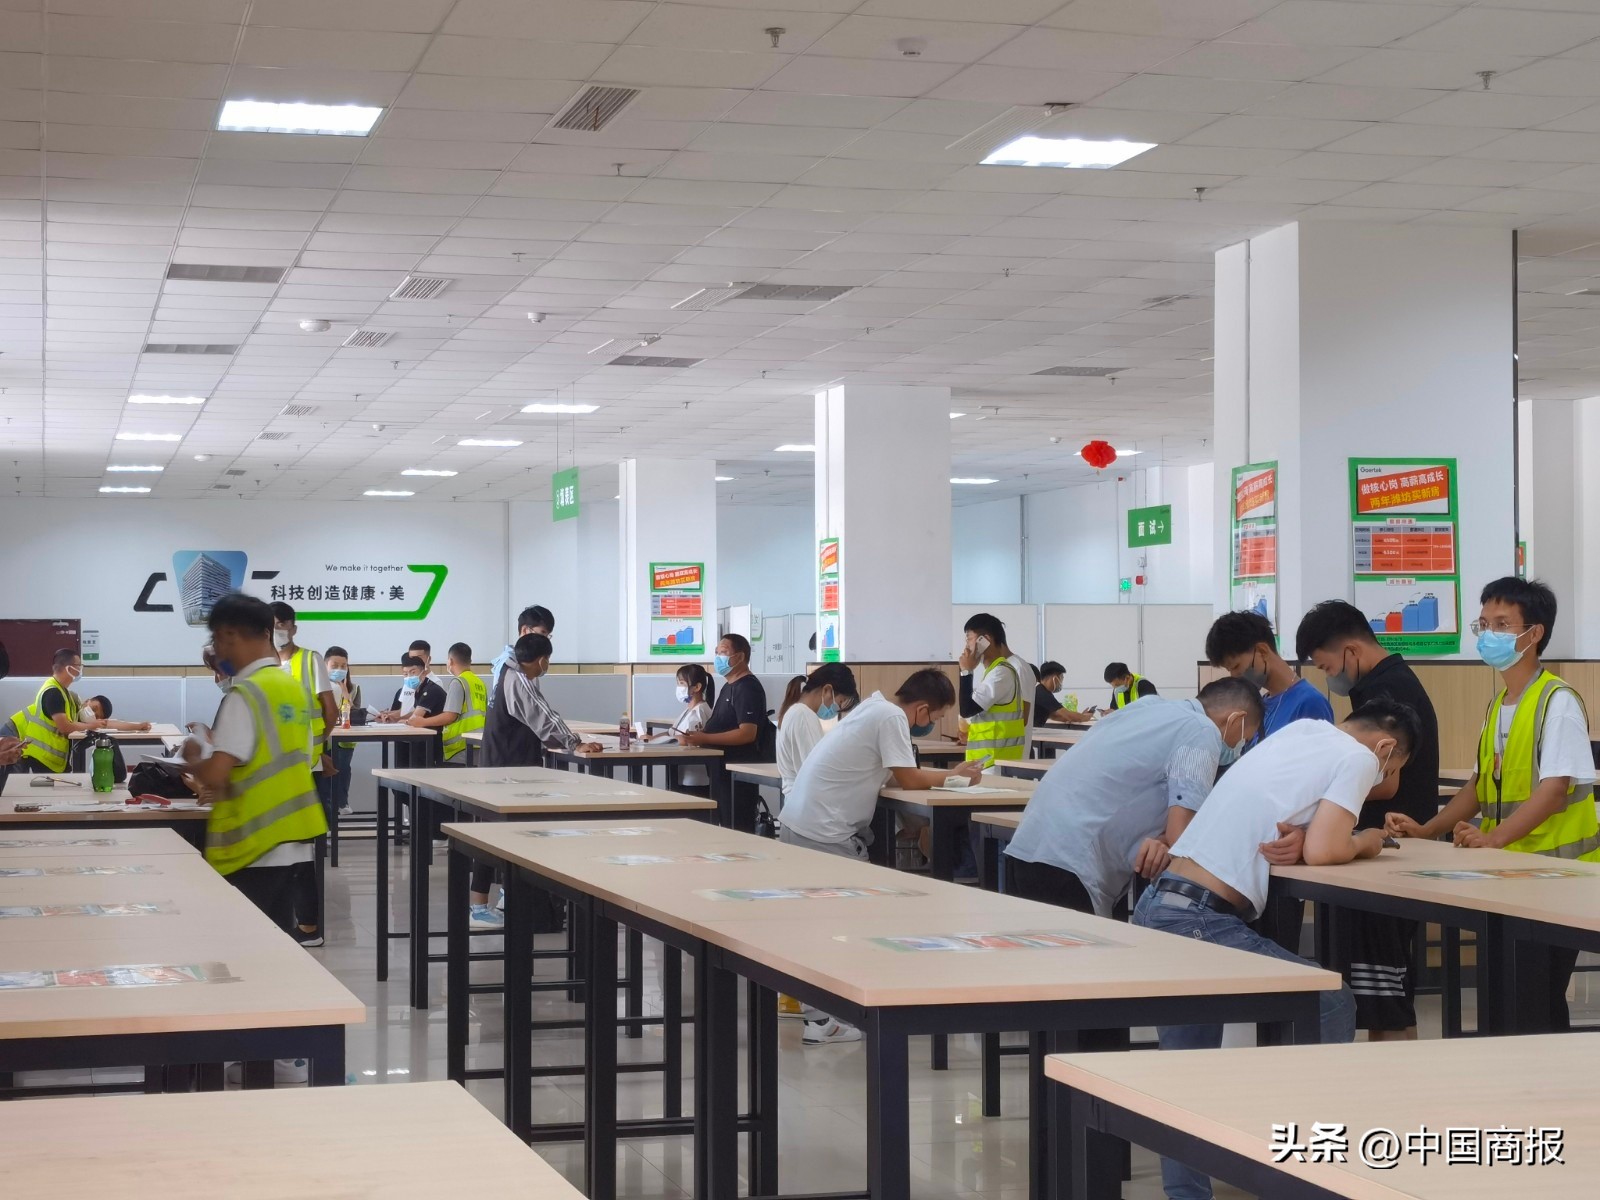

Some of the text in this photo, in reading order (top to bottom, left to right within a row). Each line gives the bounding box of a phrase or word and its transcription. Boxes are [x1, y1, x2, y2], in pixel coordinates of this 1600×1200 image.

[1400, 470, 1444, 488] 高薪高成长
[325, 564, 338, 572] We
[339, 563, 362, 572] make
[370, 564, 404, 574] together
